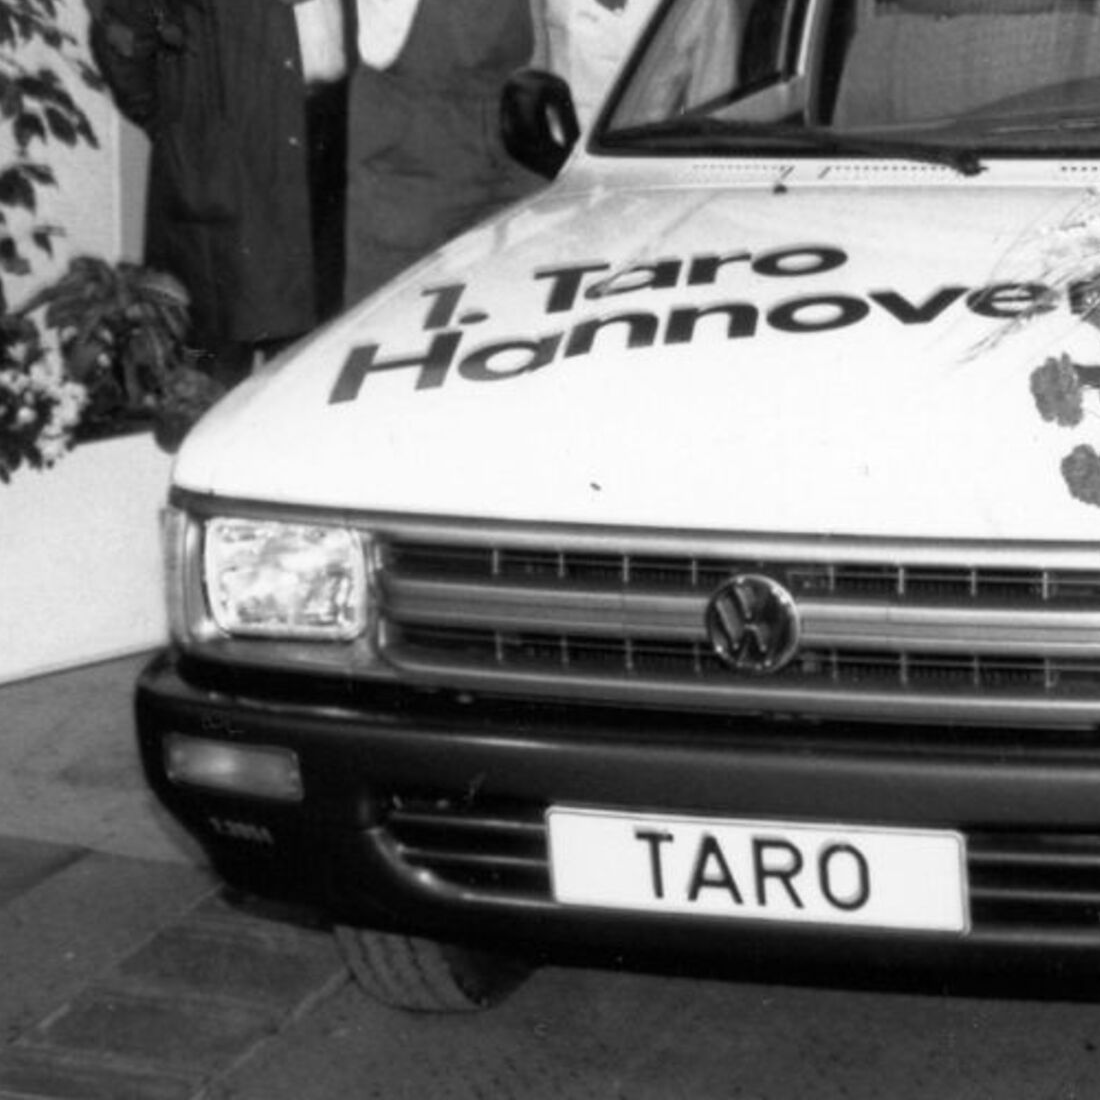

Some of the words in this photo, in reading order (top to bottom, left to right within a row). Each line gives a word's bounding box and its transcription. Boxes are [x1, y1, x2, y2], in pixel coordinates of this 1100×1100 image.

[420, 283, 488, 330] 1.
[535, 246, 848, 302] Taro
[634, 830, 871, 911] TARO
